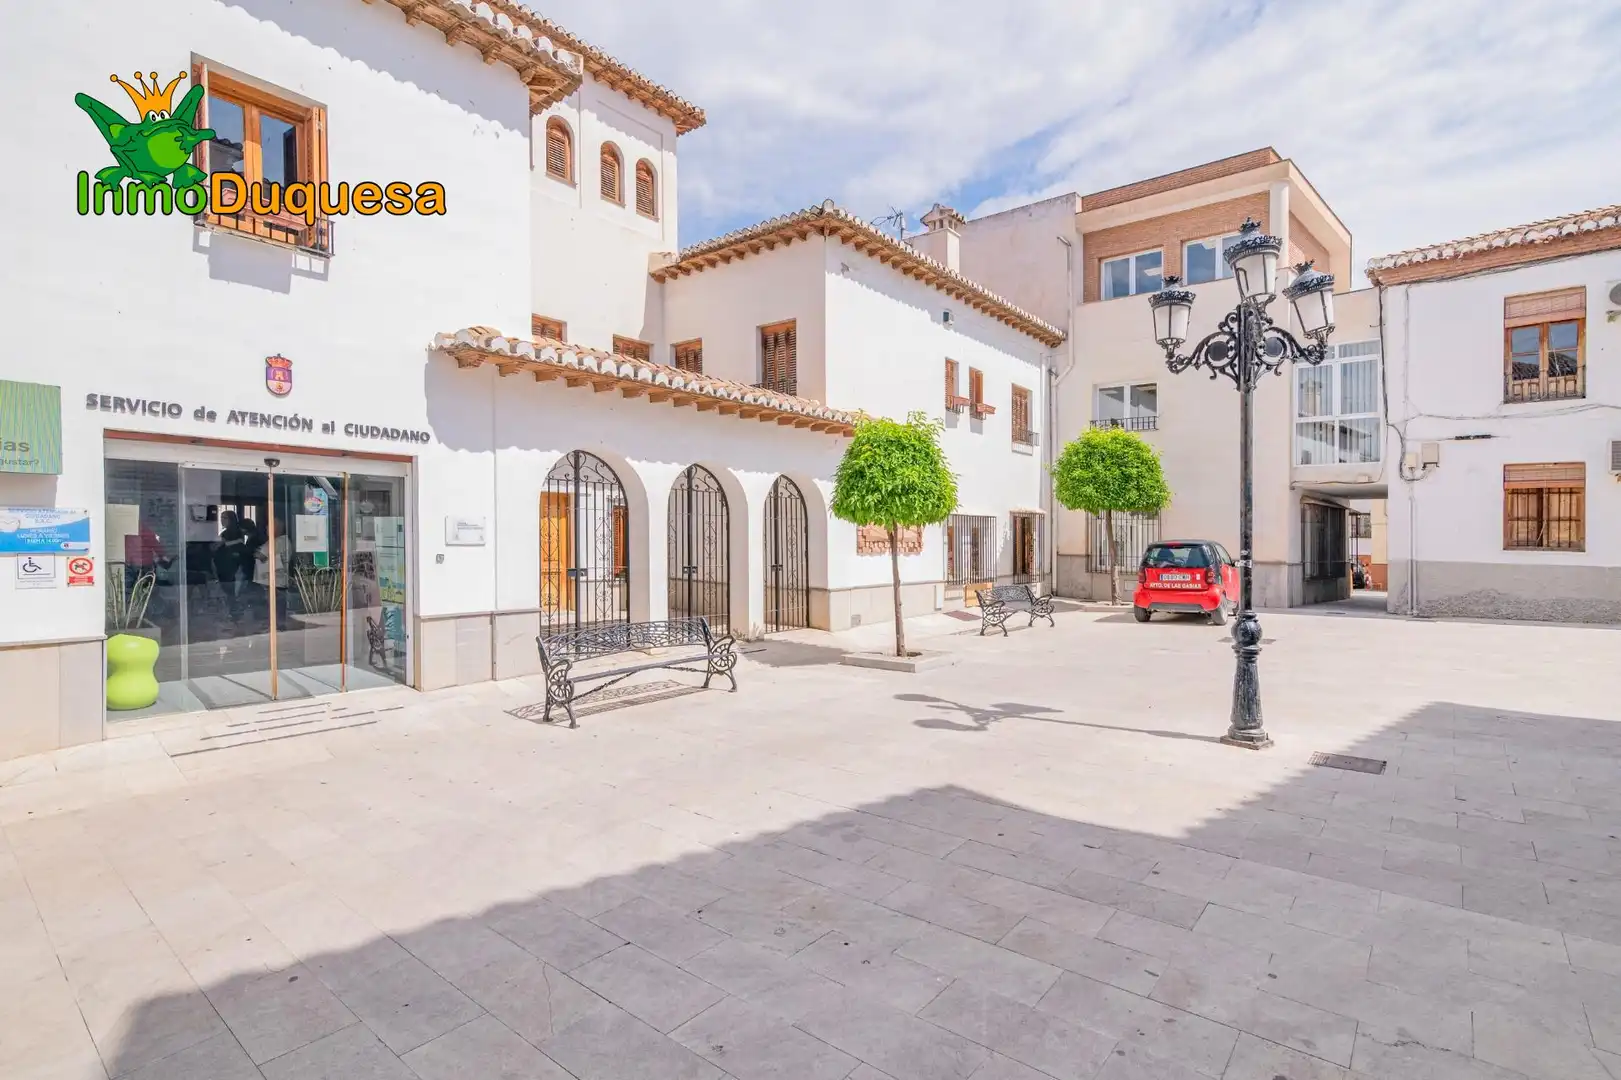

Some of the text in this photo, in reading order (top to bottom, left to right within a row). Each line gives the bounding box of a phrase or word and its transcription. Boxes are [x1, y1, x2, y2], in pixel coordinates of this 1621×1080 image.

[86, 393, 431, 445] SERVICIO de ATENCIÓN al CIUDADANO
